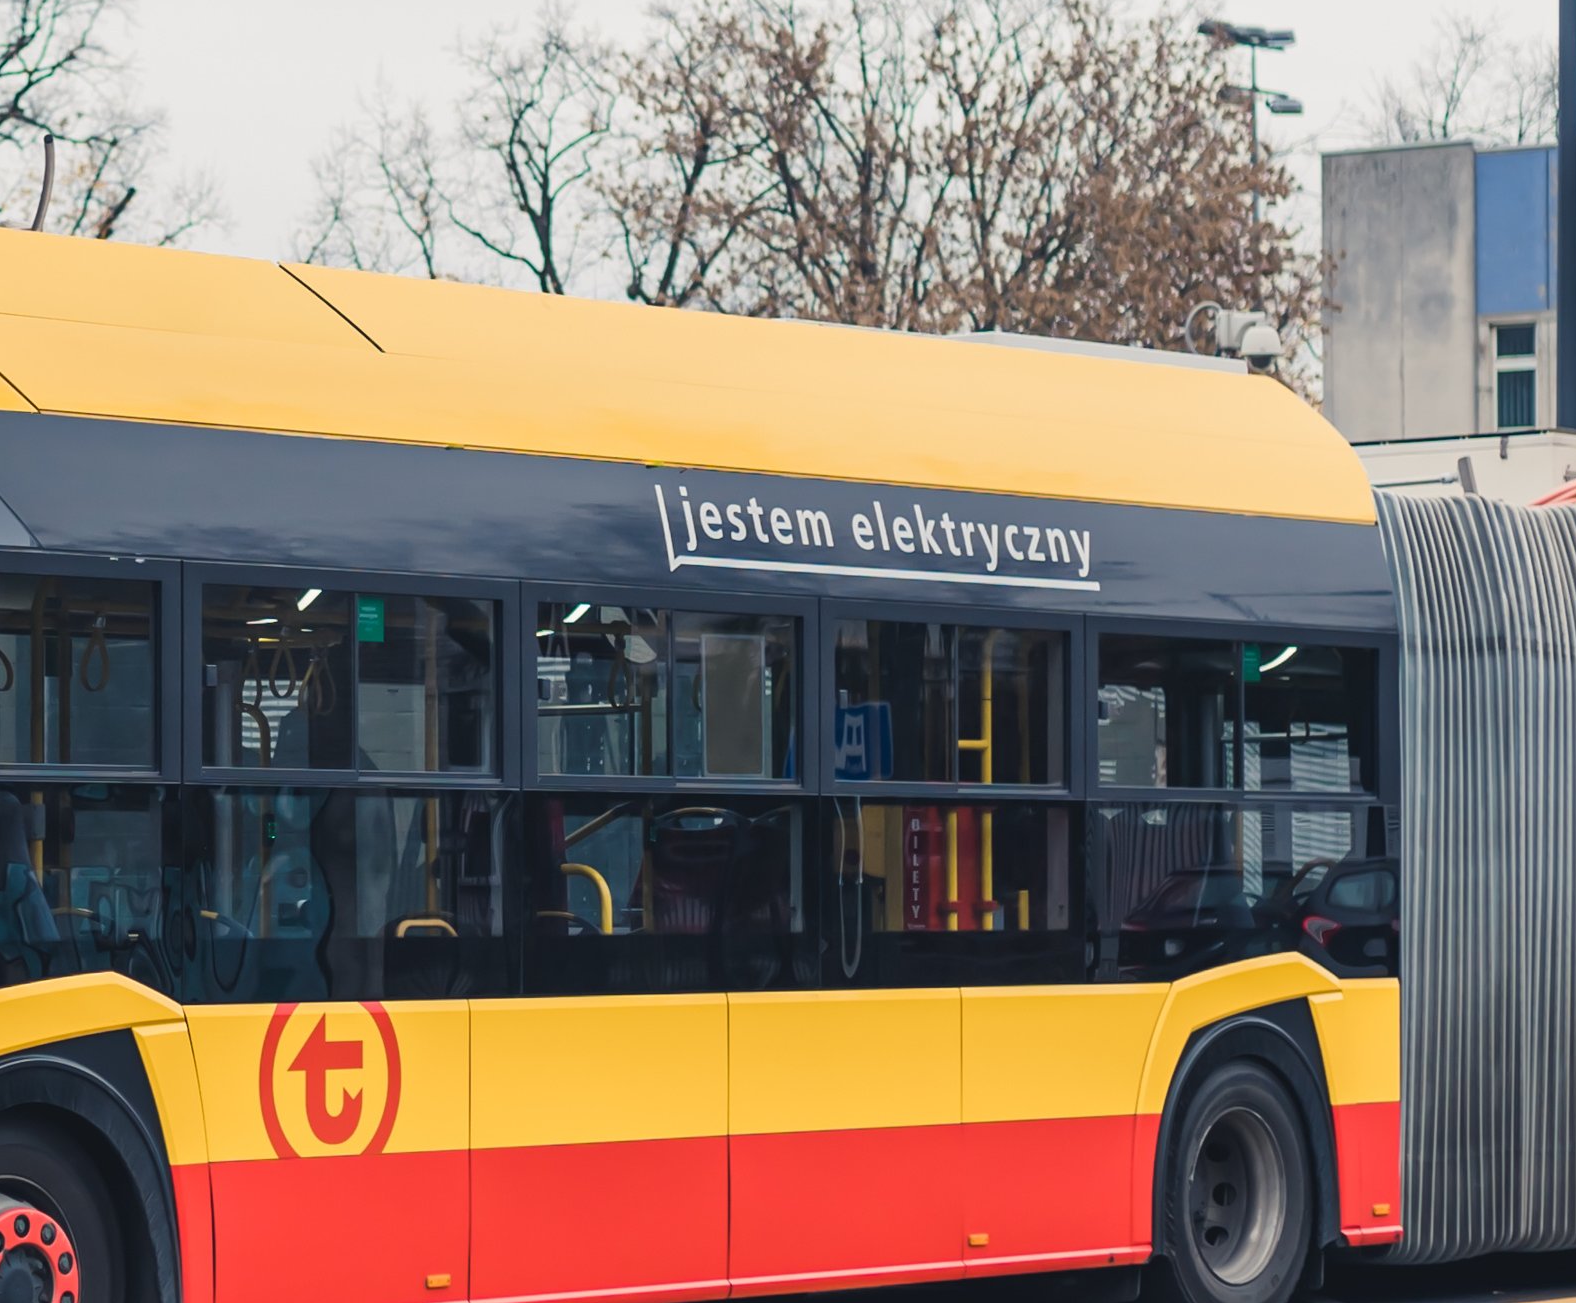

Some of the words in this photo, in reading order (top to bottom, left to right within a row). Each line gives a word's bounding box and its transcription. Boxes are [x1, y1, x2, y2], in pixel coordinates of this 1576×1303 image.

[679, 485, 835, 552] jestem
[851, 500, 1091, 578] elektryczny
[911, 818, 921, 919] BILETY
